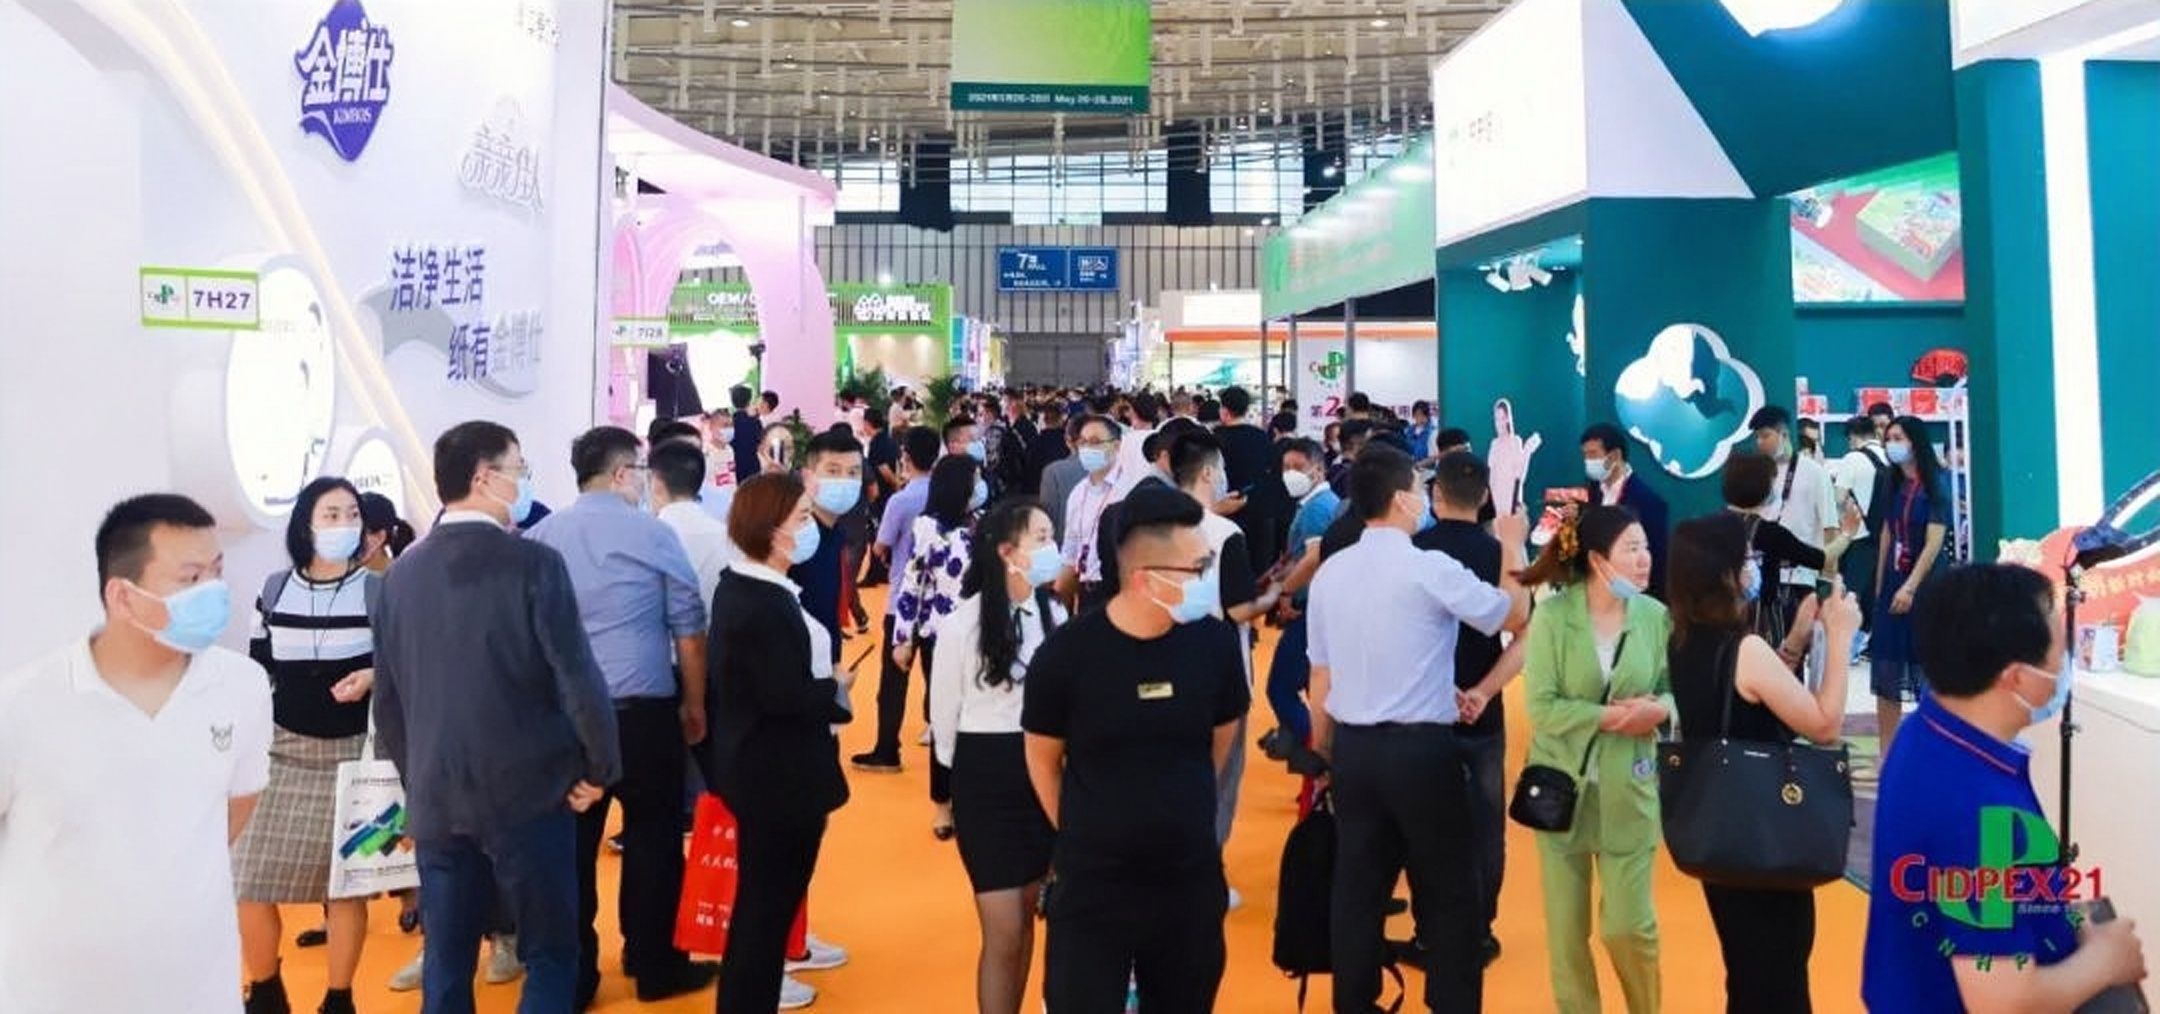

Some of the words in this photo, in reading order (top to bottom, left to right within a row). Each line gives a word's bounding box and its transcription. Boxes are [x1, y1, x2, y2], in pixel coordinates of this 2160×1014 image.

[299, 20, 393, 106] 金博仕
[1054, 94, 1075, 105] May
[390, 249, 484, 310] 洁净生活
[193, 291, 251, 310] 7H27
